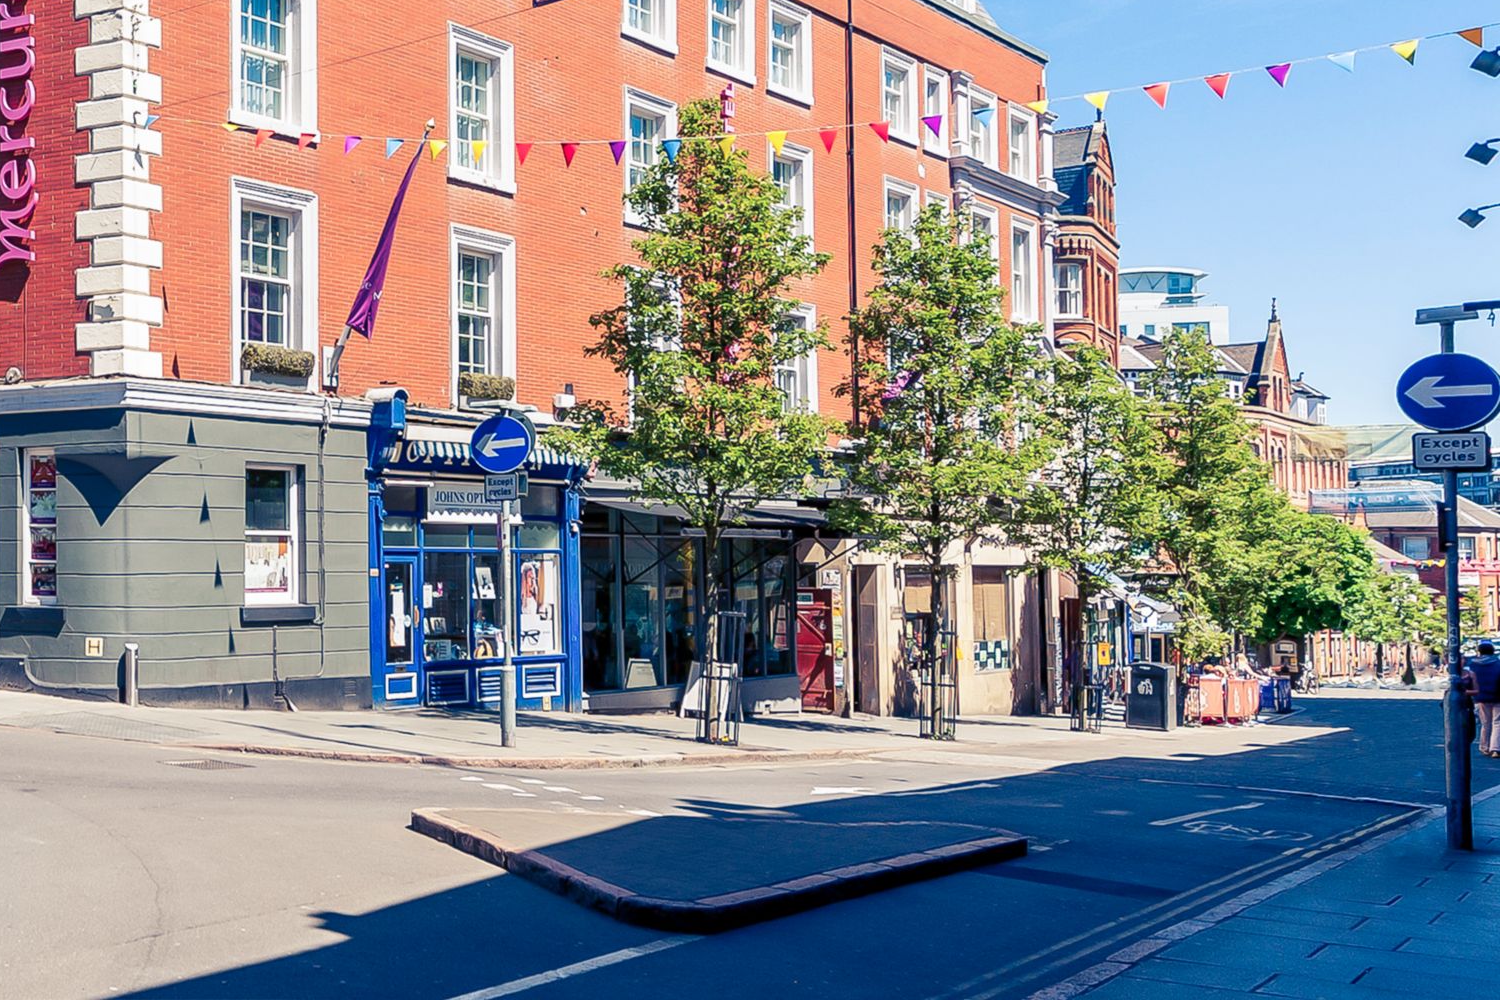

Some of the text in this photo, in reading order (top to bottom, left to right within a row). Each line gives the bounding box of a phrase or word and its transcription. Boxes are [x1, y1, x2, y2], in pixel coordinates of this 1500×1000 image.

[1421, 437, 1479, 449] Except
[1424, 451, 1477, 463] cycles
[488, 477, 514, 486] Except
[435, 490, 465, 503] JOHNS
[489, 488, 511, 496] cycles
[88, 640, 100, 654] H
